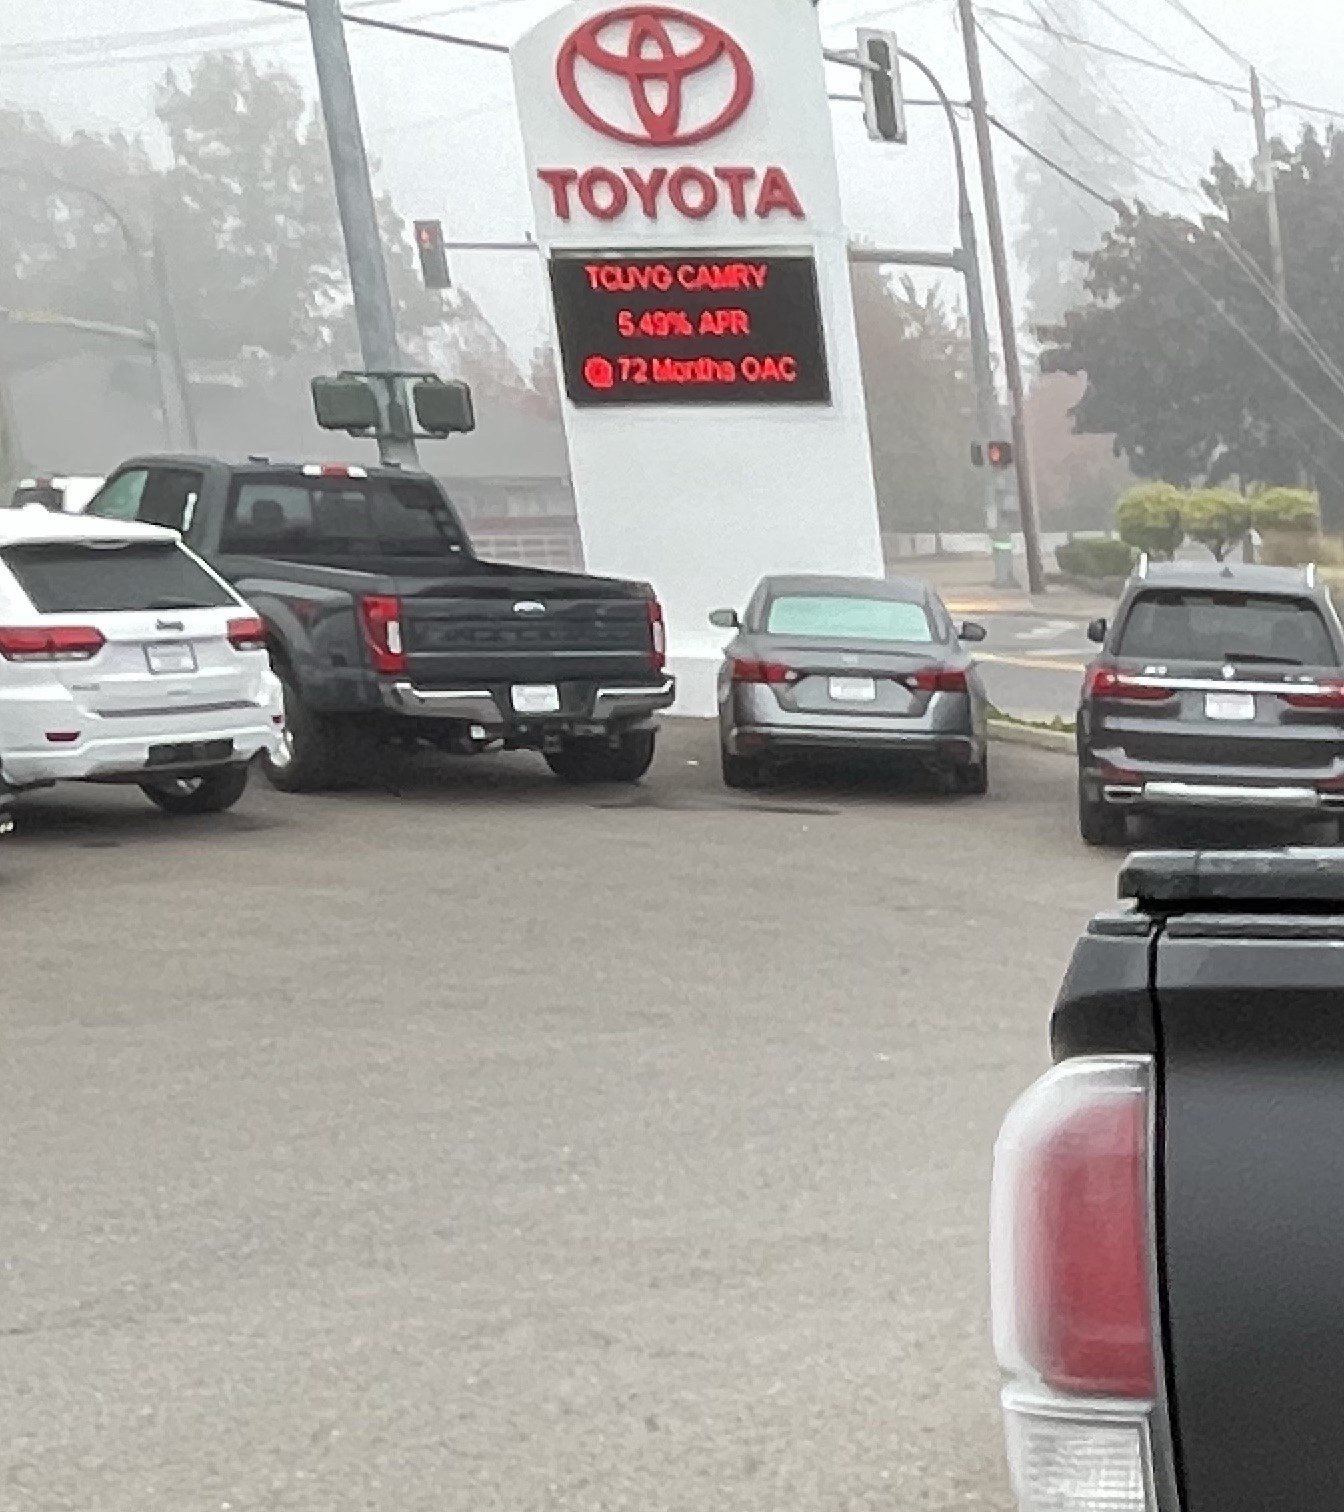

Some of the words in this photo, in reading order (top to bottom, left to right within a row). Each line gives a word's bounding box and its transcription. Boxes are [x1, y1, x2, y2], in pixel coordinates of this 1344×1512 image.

[537, 166, 806, 220] TOYOTA
[676, 264, 768, 291] CAMRY
[698, 310, 750, 335] APR
[617, 357, 649, 383] 72
[652, 356, 736, 383] Months
[740, 356, 797, 382] OAC
